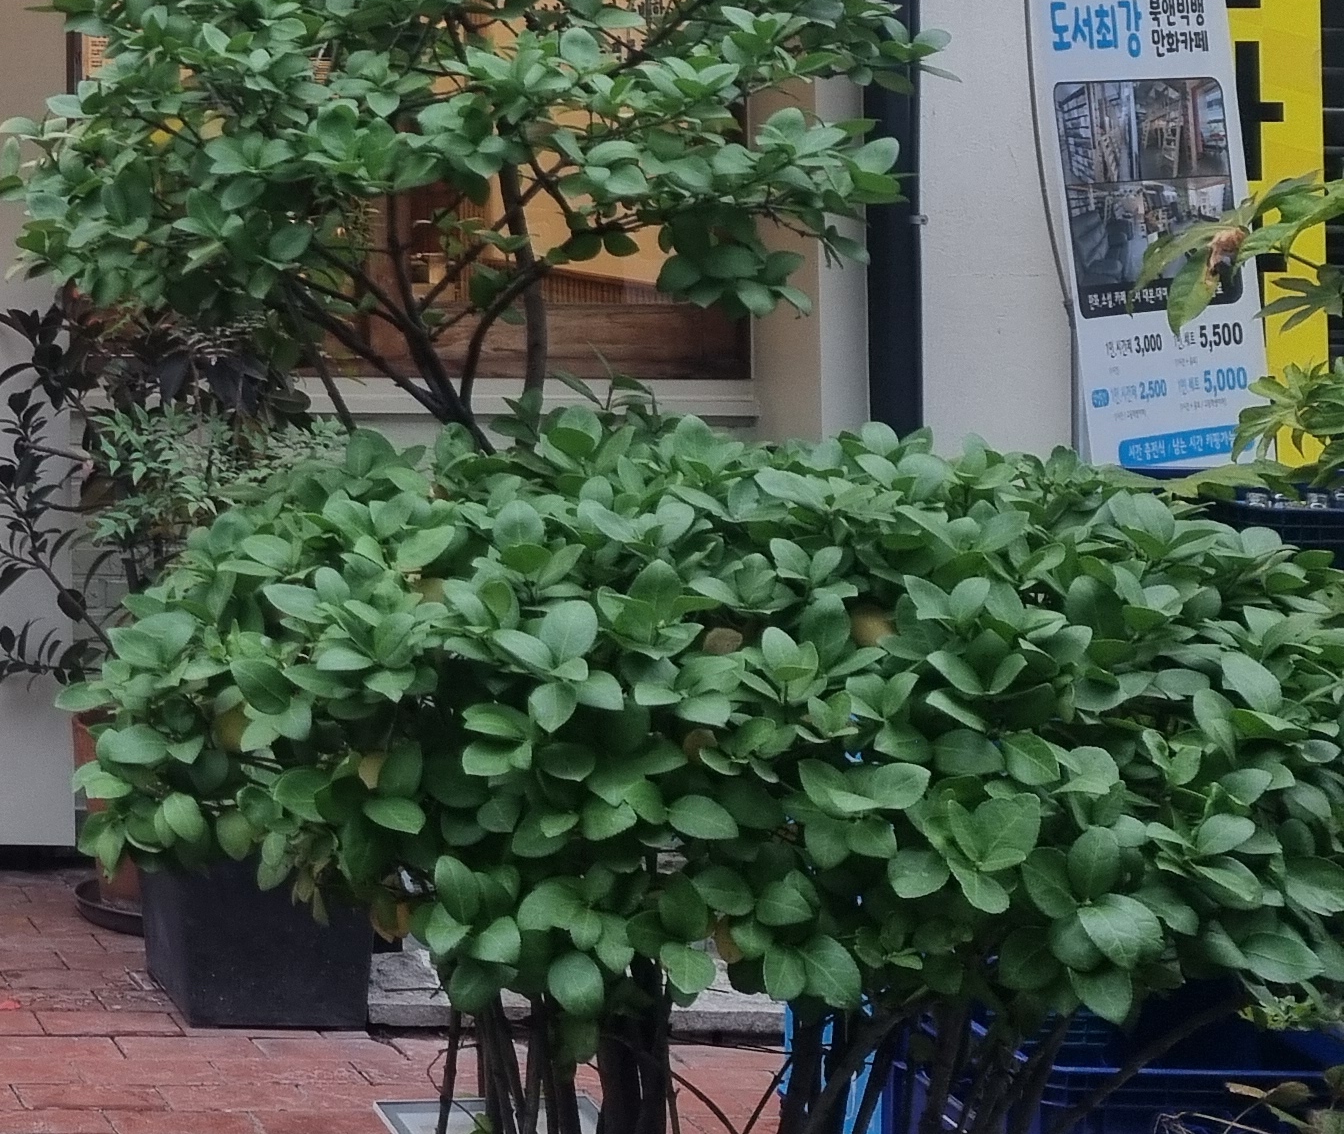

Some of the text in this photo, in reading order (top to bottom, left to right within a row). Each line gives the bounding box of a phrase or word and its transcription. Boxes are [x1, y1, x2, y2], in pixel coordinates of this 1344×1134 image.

[1152, 29, 1210, 58] 만화카페
[1134, 332, 1163, 357] 3,000
[1199, 322, 1244, 353] 5,500
[1138, 379, 1168, 402] 2,500
[1203, 366, 1248, 397] 5,000
